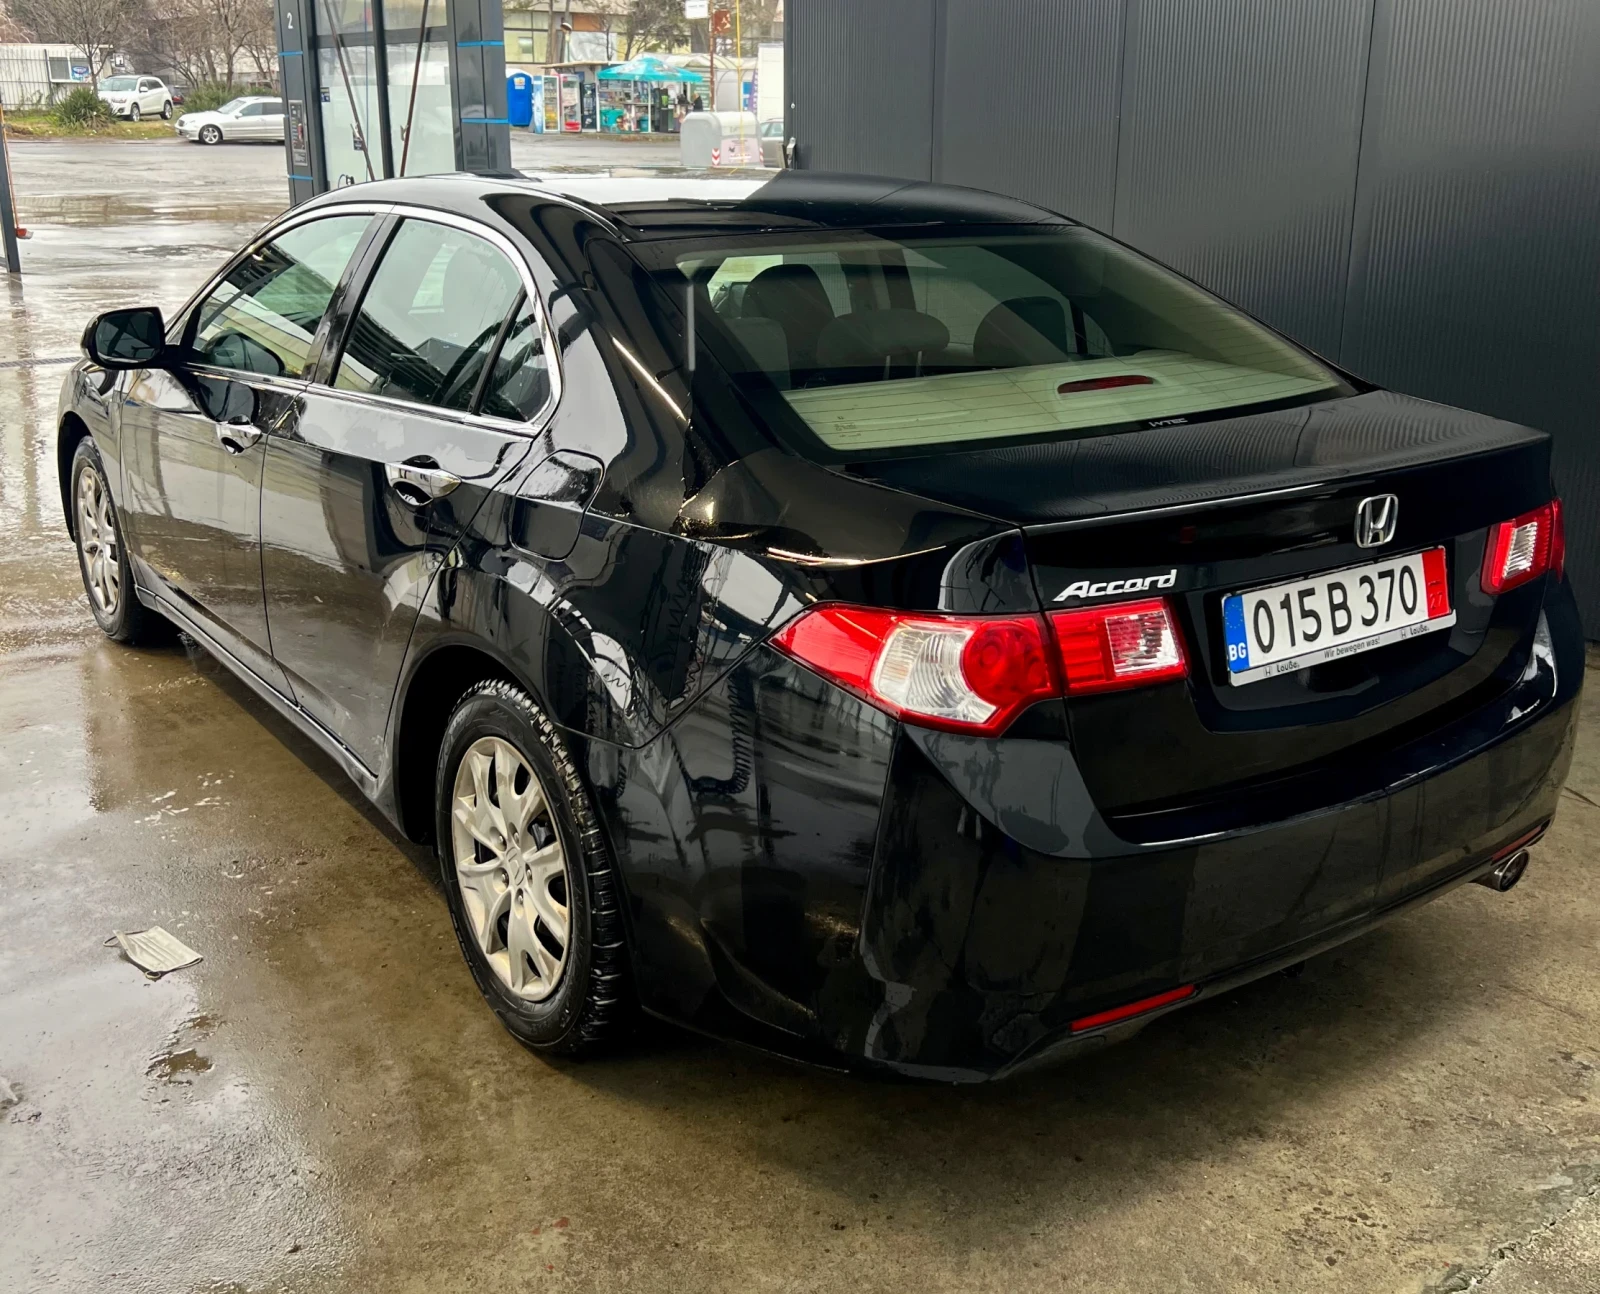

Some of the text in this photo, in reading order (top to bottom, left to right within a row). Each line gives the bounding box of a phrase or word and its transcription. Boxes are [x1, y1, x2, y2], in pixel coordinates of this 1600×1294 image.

[286, 12, 294, 30] 2
[1052, 569, 1178, 602] Accord
[1228, 642, 1247, 661] BG
[1323, 649, 1335, 659] Wir
[1336, 641, 1365, 656] bewegen
